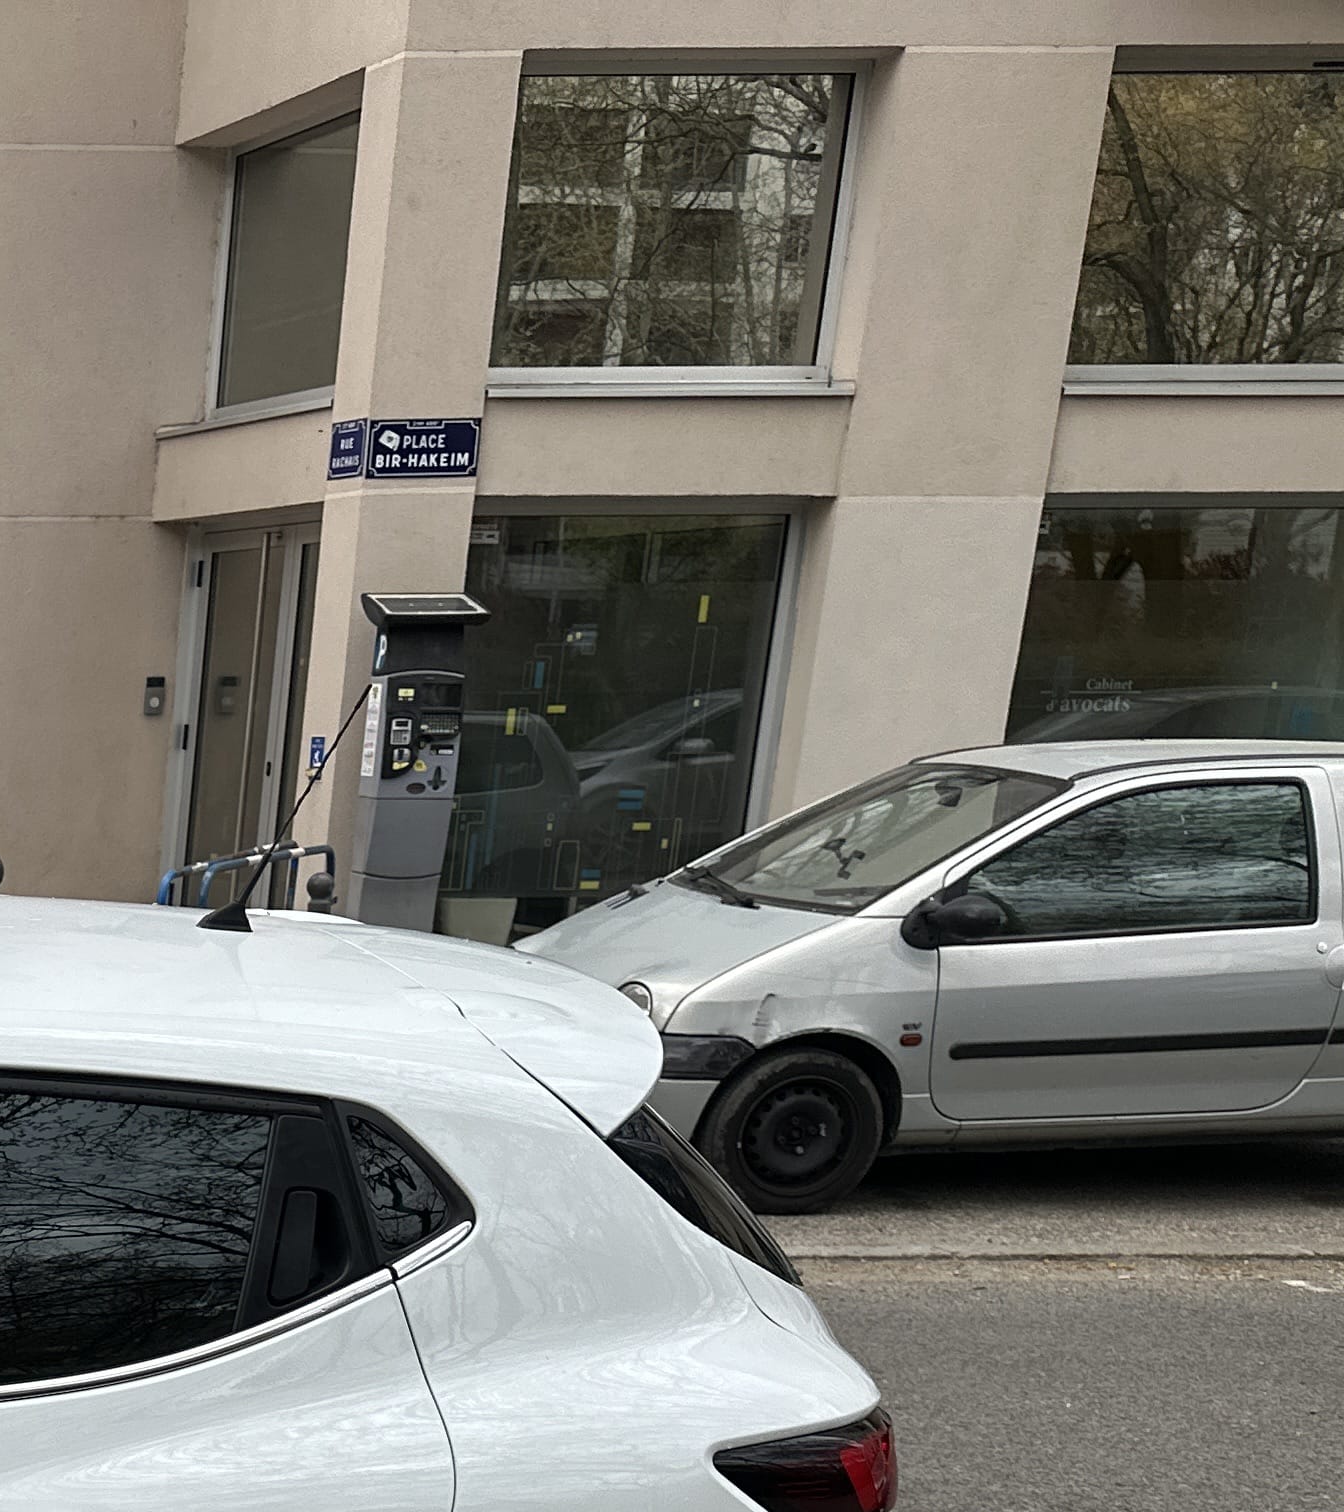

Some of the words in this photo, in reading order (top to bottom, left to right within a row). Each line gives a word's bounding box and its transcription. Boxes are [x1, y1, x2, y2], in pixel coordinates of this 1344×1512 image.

[340, 437, 355, 450] RUE
[402, 434, 446, 449] PLACE
[375, 452, 470, 468] BIR-HAKEIM
[1086, 678, 1134, 690] Cabinet
[1045, 696, 1131, 712] d'avocats
